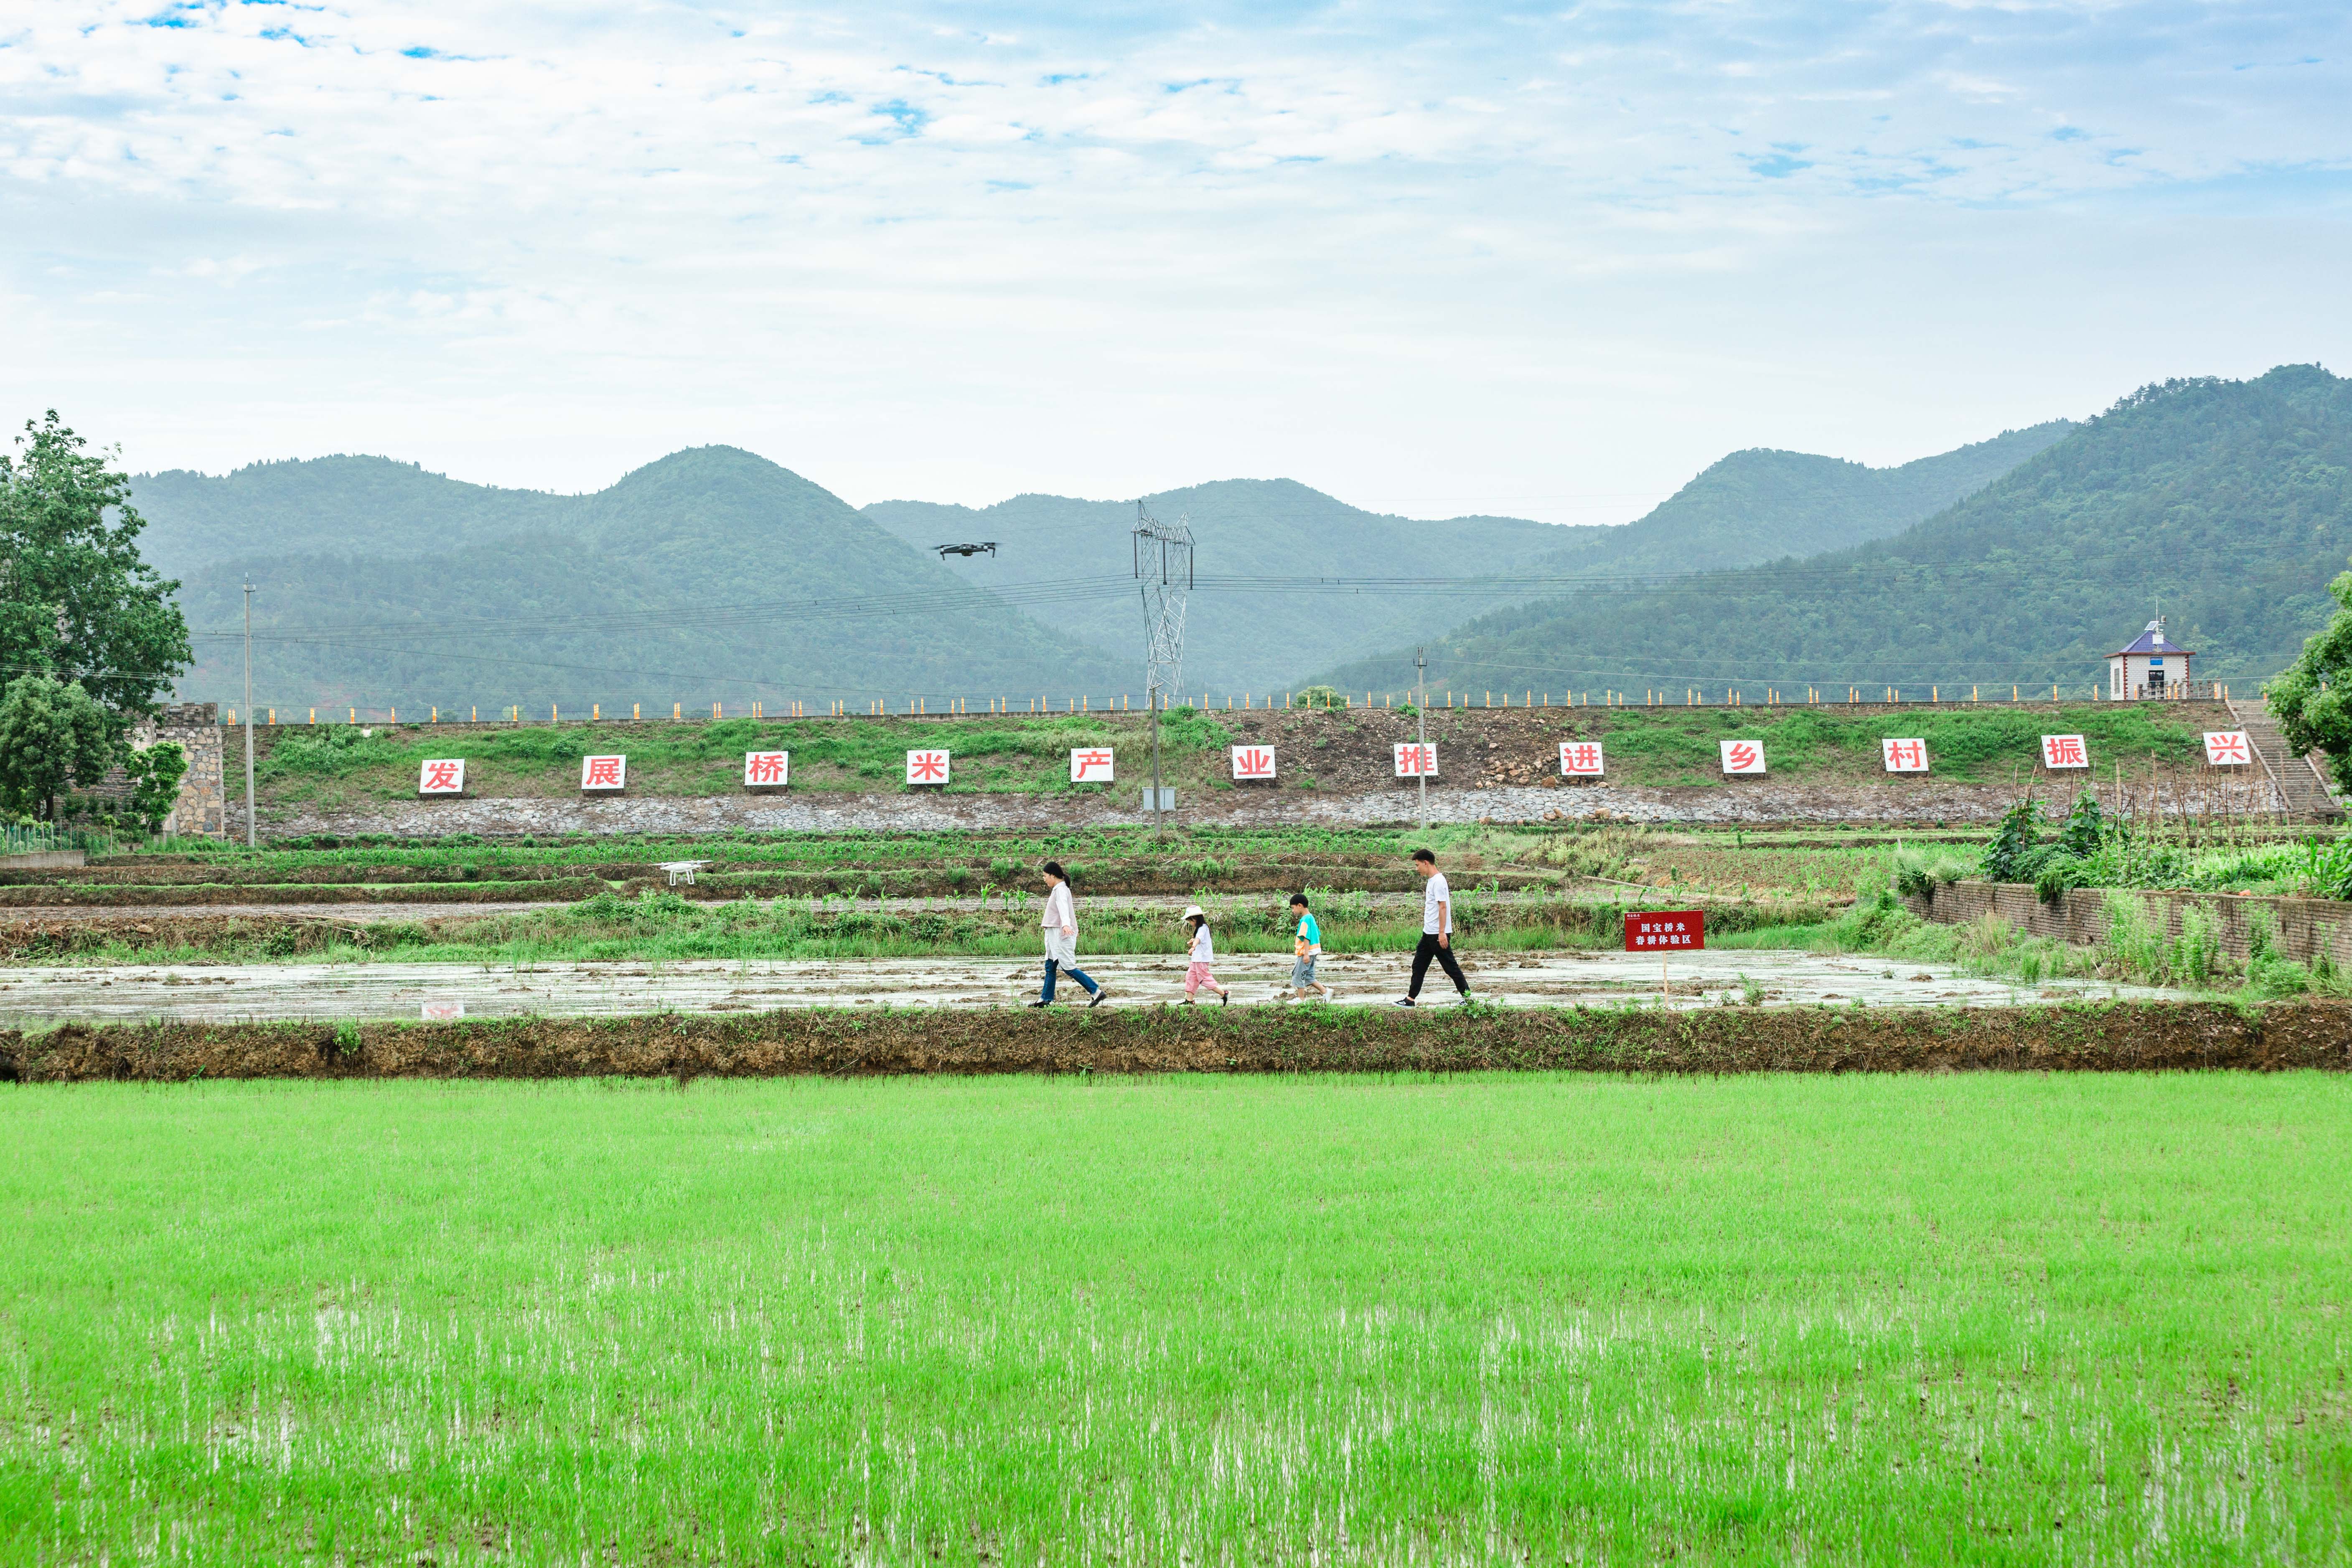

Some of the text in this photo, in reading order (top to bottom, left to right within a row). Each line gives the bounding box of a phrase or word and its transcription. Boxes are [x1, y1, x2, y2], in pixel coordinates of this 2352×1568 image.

[425, 735, 2245, 789] 发 展 桥 米 产 业 推 进 乡 村 振 兴
[1641, 923, 1685, 933] 国宝桥米
[1635, 935, 1691, 945] 春耕体验区
